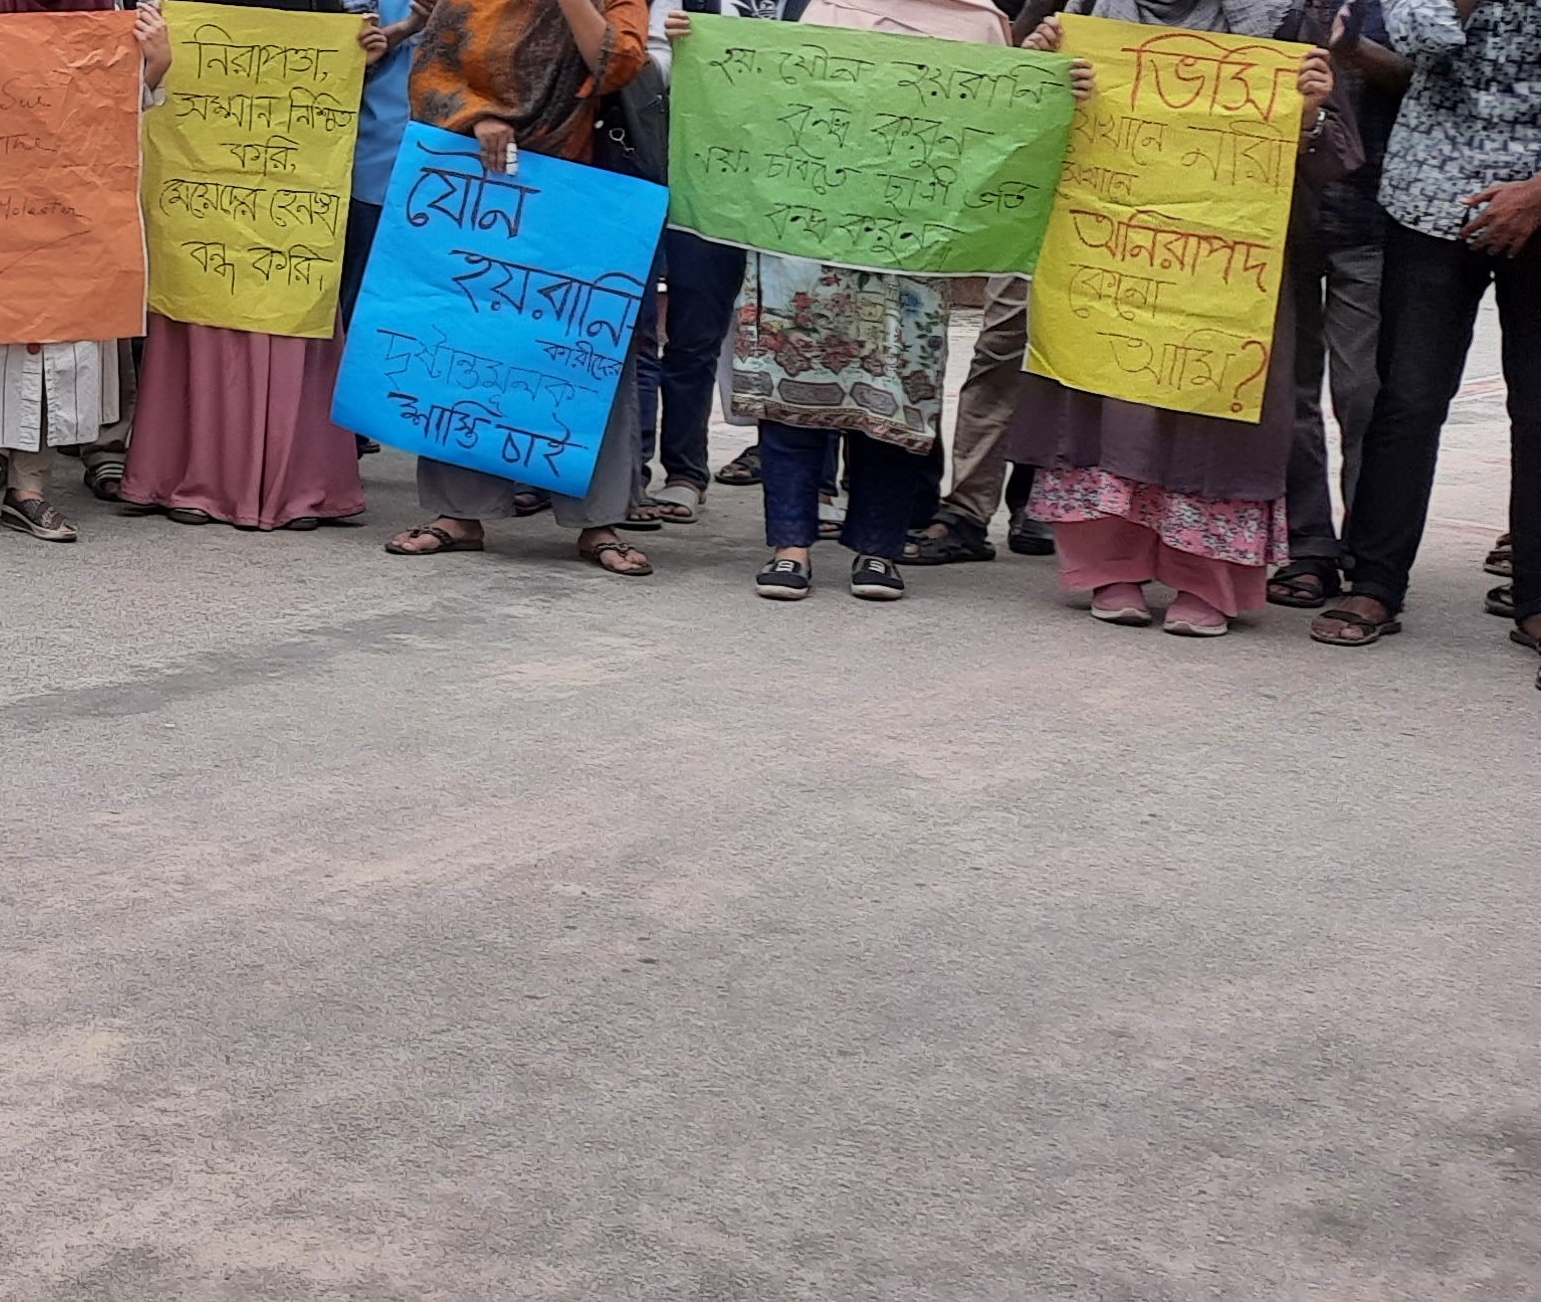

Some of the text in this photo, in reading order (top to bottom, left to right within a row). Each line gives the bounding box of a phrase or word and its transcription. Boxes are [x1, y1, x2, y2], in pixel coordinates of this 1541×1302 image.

[181, 23, 339, 83] নিরাপত্তা,
[780, 43, 876, 85] যৌন
[891, 59, 1065, 108] হয়রানি
[172, 85, 357, 134] সম্মান নিশ্চিত
[777, 103, 996, 170] বন্ধ করুন
[220, 134, 299, 177] করি,
[1180, 119, 1300, 194] নারী
[159, 178, 268, 222] মেয়েদের
[406, 140, 542, 239] যৌন
[764, 202, 828, 244] বন্ধ
[1069, 208, 1272, 293] অনিরাপদ
[181, 240, 235, 296] বন্ধ
[1068, 262, 1178, 322] কেনো
[376, 325, 599, 413] দৃষ্টান্তমূলক
[534, 338, 624, 380] কারীদের
[387, 390, 590, 478] শাস্তি চাই
